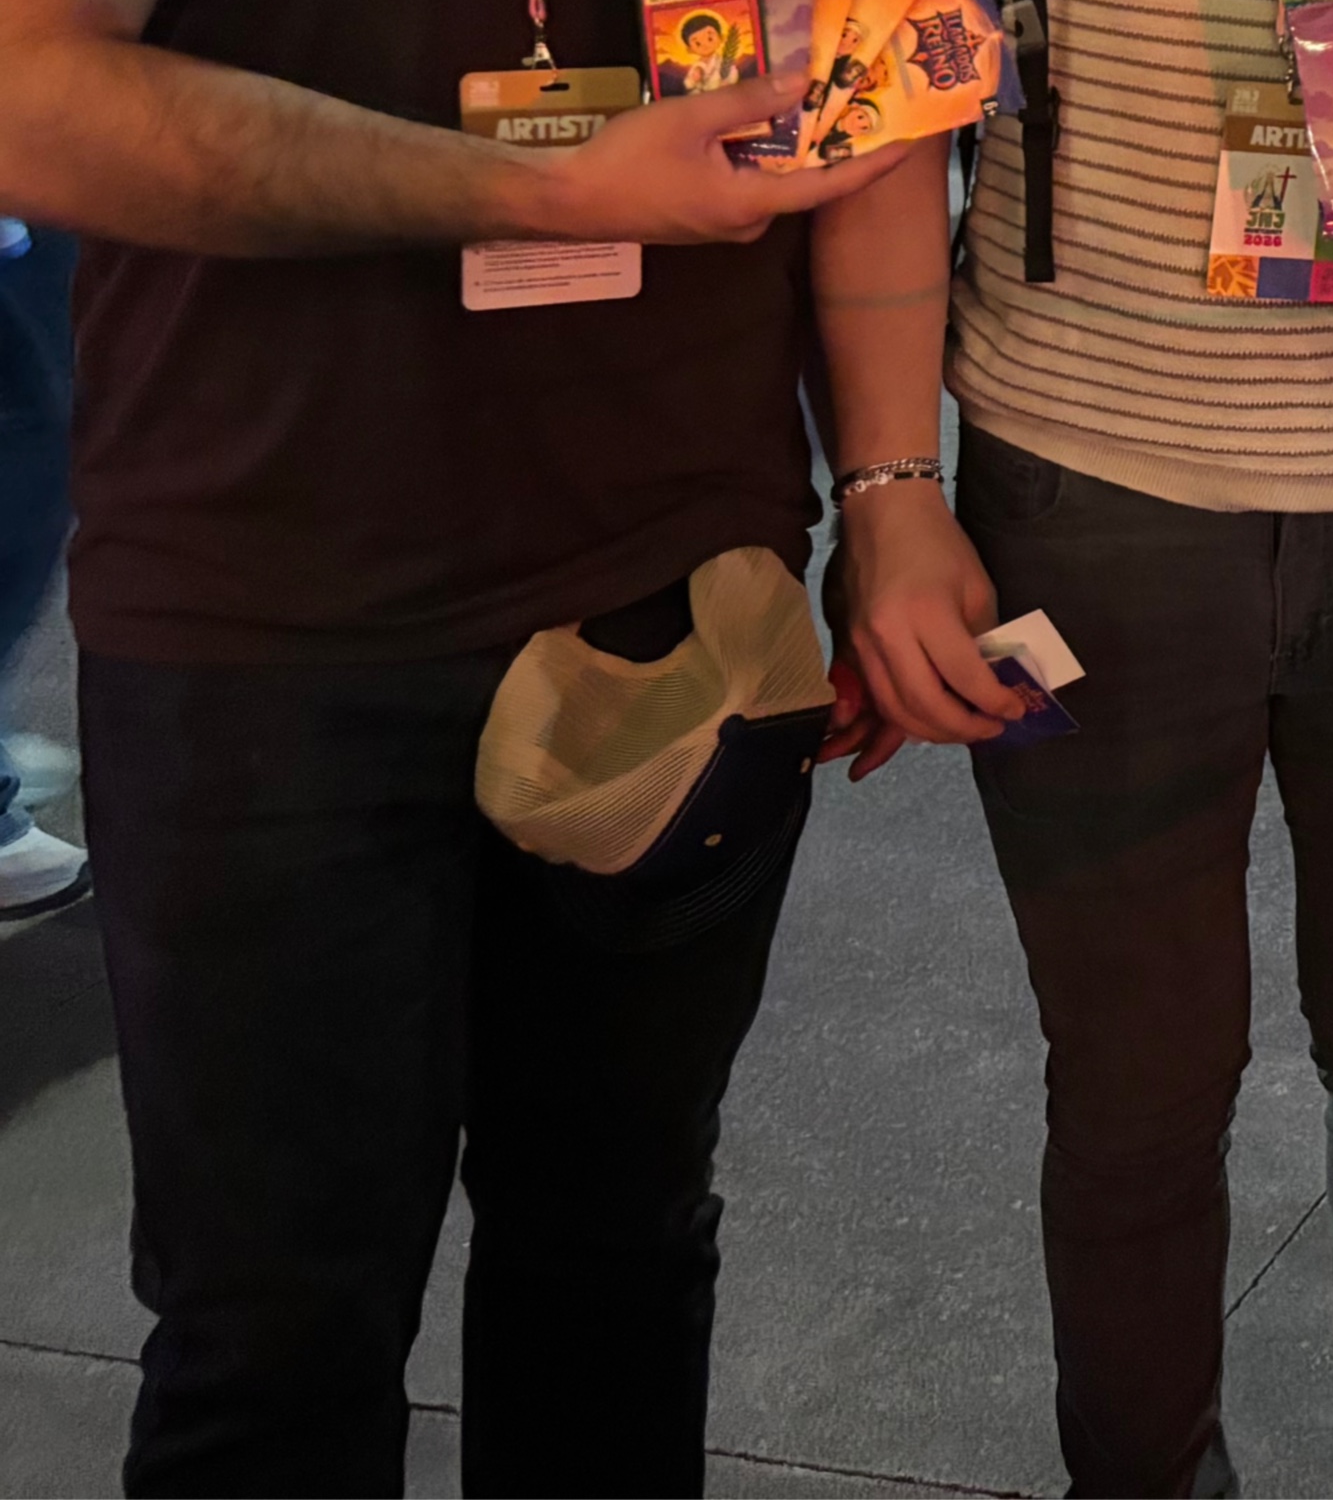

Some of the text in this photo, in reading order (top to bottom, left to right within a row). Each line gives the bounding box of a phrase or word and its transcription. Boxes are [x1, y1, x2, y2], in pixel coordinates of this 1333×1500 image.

[920, 17, 957, 91] REINO
[945, 8, 977, 83] LLAMADOS
[1250, 124, 1309, 151] ARTI
[1243, 234, 1283, 248] 2026
